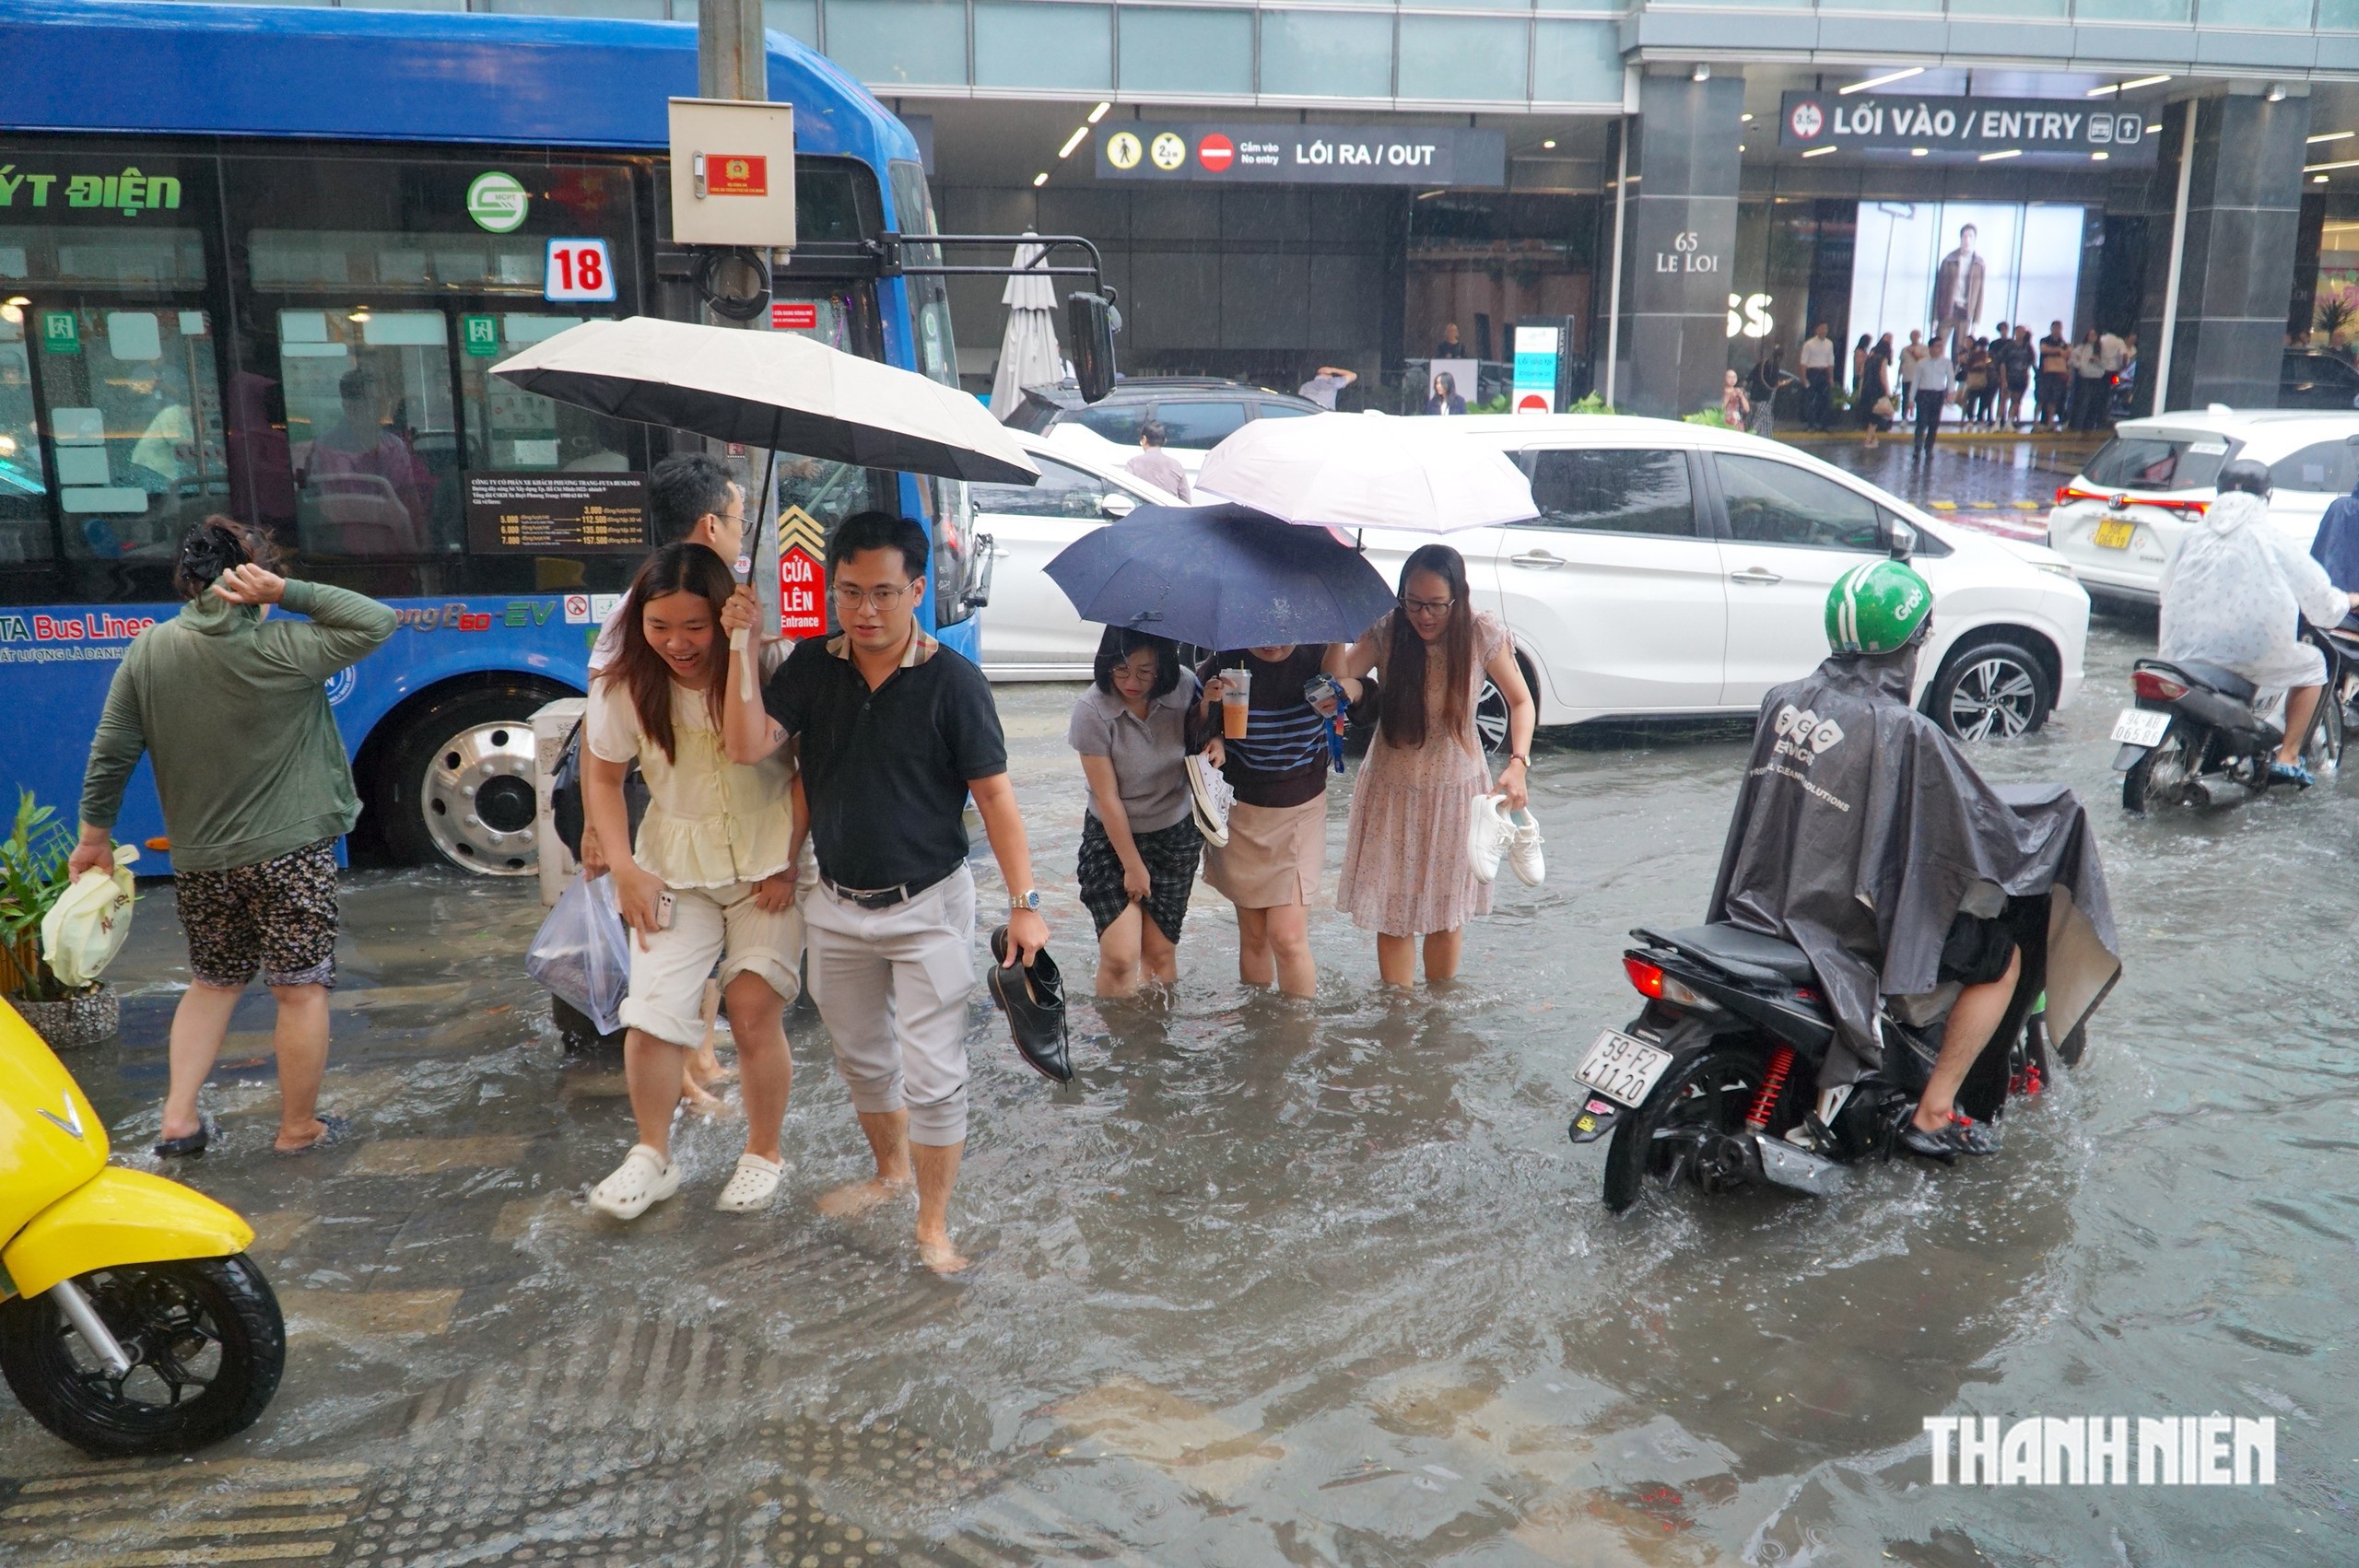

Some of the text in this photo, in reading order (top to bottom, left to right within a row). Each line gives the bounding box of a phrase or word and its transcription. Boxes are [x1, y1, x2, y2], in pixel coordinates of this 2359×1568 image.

[1834, 99, 1884, 135] LỐI
[1890, 102, 1956, 138] VÀO
[1981, 111, 2082, 140] ENTRY
[1241, 154, 1279, 166] No entry
[1296, 139, 1333, 164] LỐI
[1339, 145, 1372, 165] RA
[1388, 144, 1436, 166] OUT
[1675, 231, 1698, 252] 65
[554, 249, 604, 291] 18
[1656, 252, 1718, 273] LE LOI
[500, 515, 519, 524] 5.000
[581, 515, 607, 524] 112.500
[500, 525, 520, 534] 6.000
[501, 535, 521, 545] 7.000
[583, 535, 608, 545] 157.500
[782, 555, 813, 582] CỬA
[783, 586, 814, 612] LÊN
[1895, 589, 1923, 621] Grab
[33, 614, 84, 641] Bus
[780, 615, 819, 628] Entrance
[17, 647, 64, 663] LƯỢNG
[65, 646, 84, 661] LÀ
[1602, 1036, 1658, 1075] 59-F2
